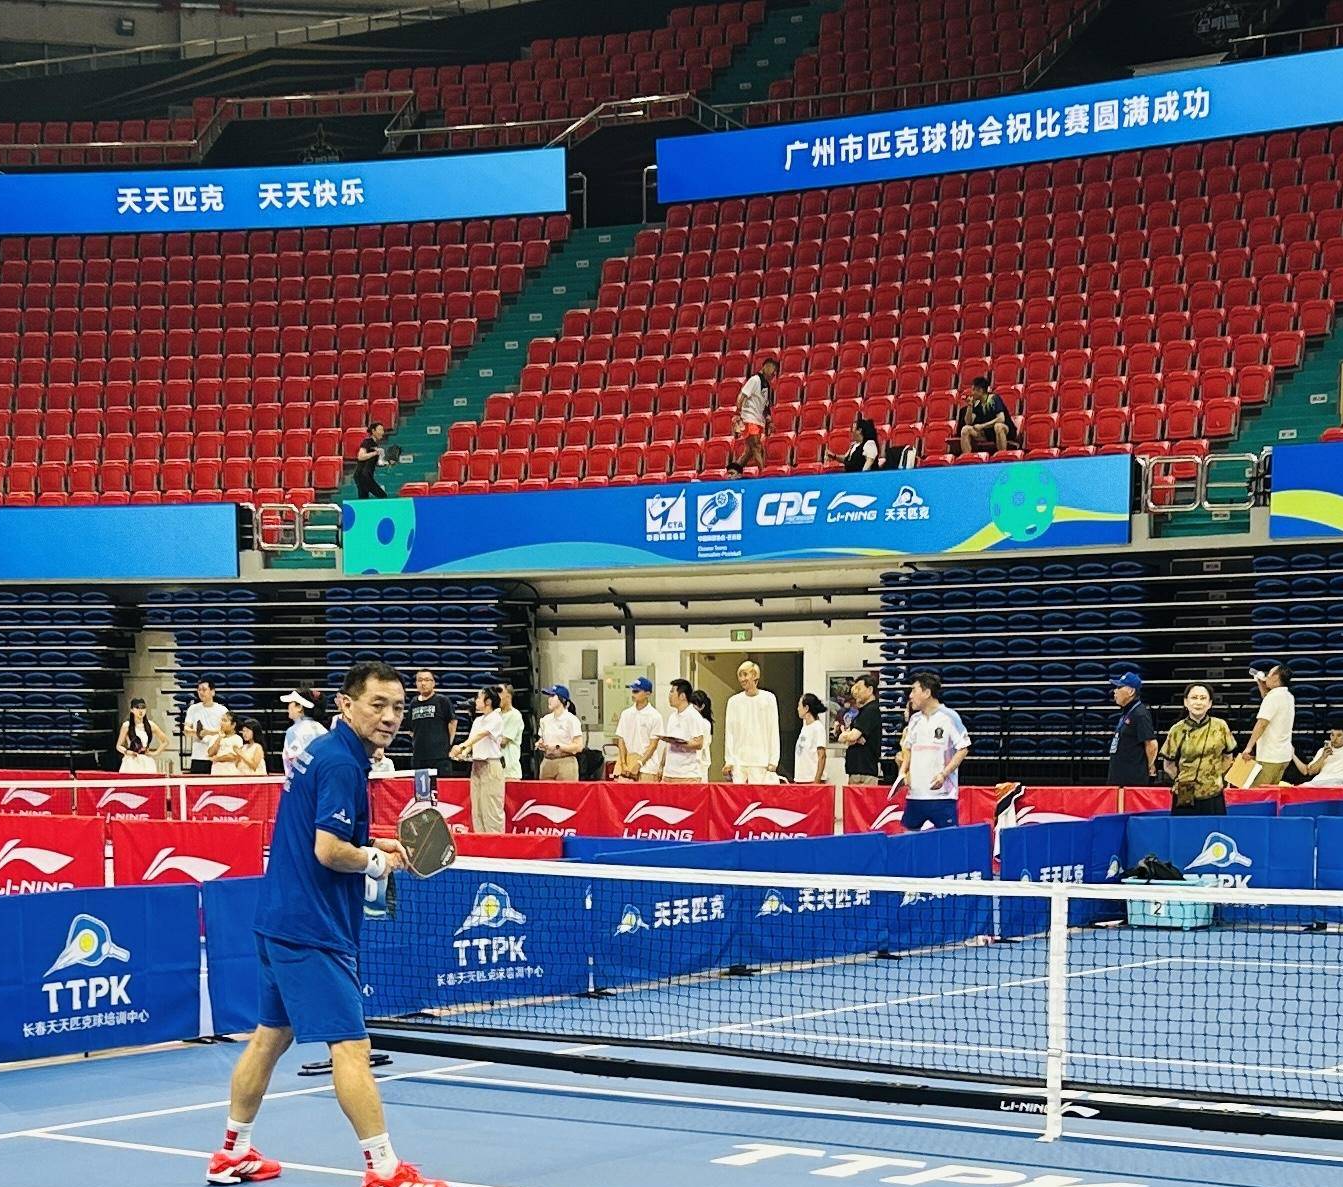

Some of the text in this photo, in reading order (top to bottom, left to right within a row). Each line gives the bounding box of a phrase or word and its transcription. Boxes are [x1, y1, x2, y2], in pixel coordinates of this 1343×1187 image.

[784, 87, 1210, 170] 广州市匹克球协会祝比赛圆满成功
[116, 178, 365, 215] 天天匹克 天天快乐
[756, 490, 820, 526] CPC
[826, 510, 877, 523] LI-NING
[654, 894, 725, 928] 天天匹克
[453, 935, 527, 967] TTPK
[42, 974, 132, 1013] TTPK
[23, 1009, 149, 1037] 长春天天匹克球培训中心
